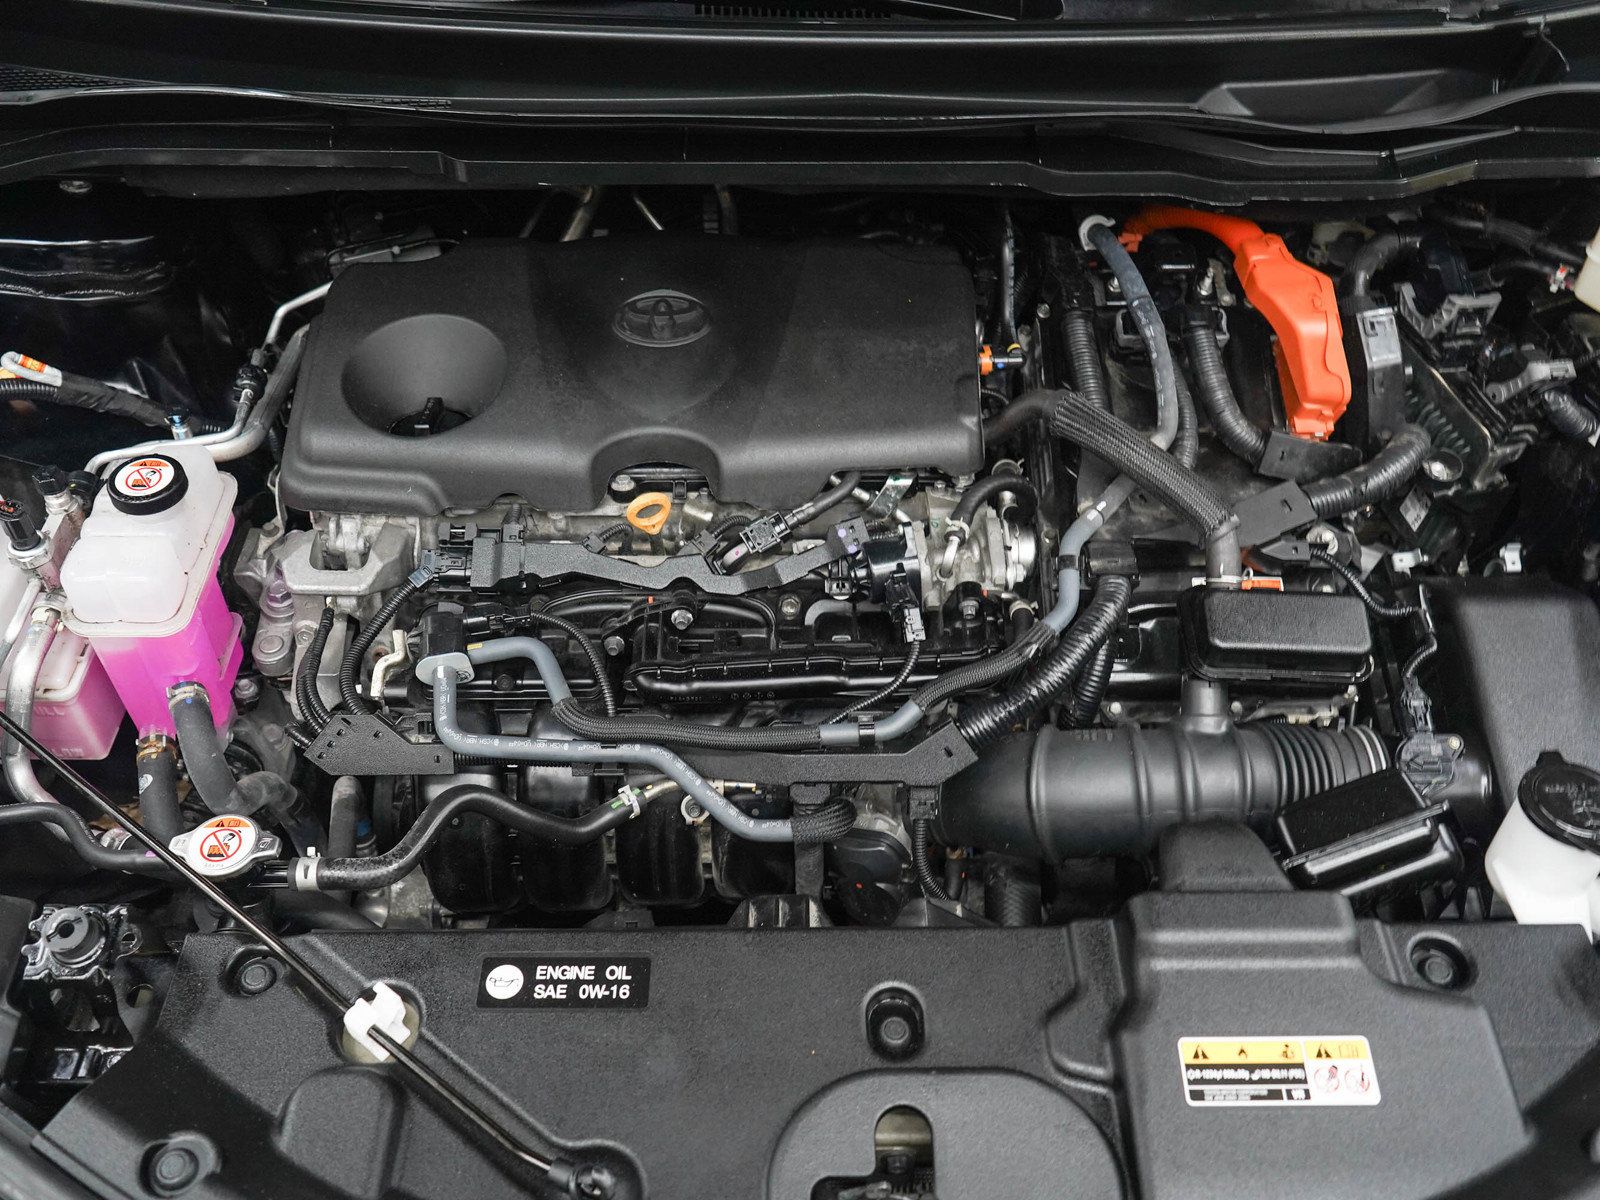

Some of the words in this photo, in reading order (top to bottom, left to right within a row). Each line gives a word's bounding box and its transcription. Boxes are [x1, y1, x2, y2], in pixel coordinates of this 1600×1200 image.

[535, 965, 596, 980] ENGINE
[605, 965, 632, 980] OIL
[533, 984, 568, 999] SAE
